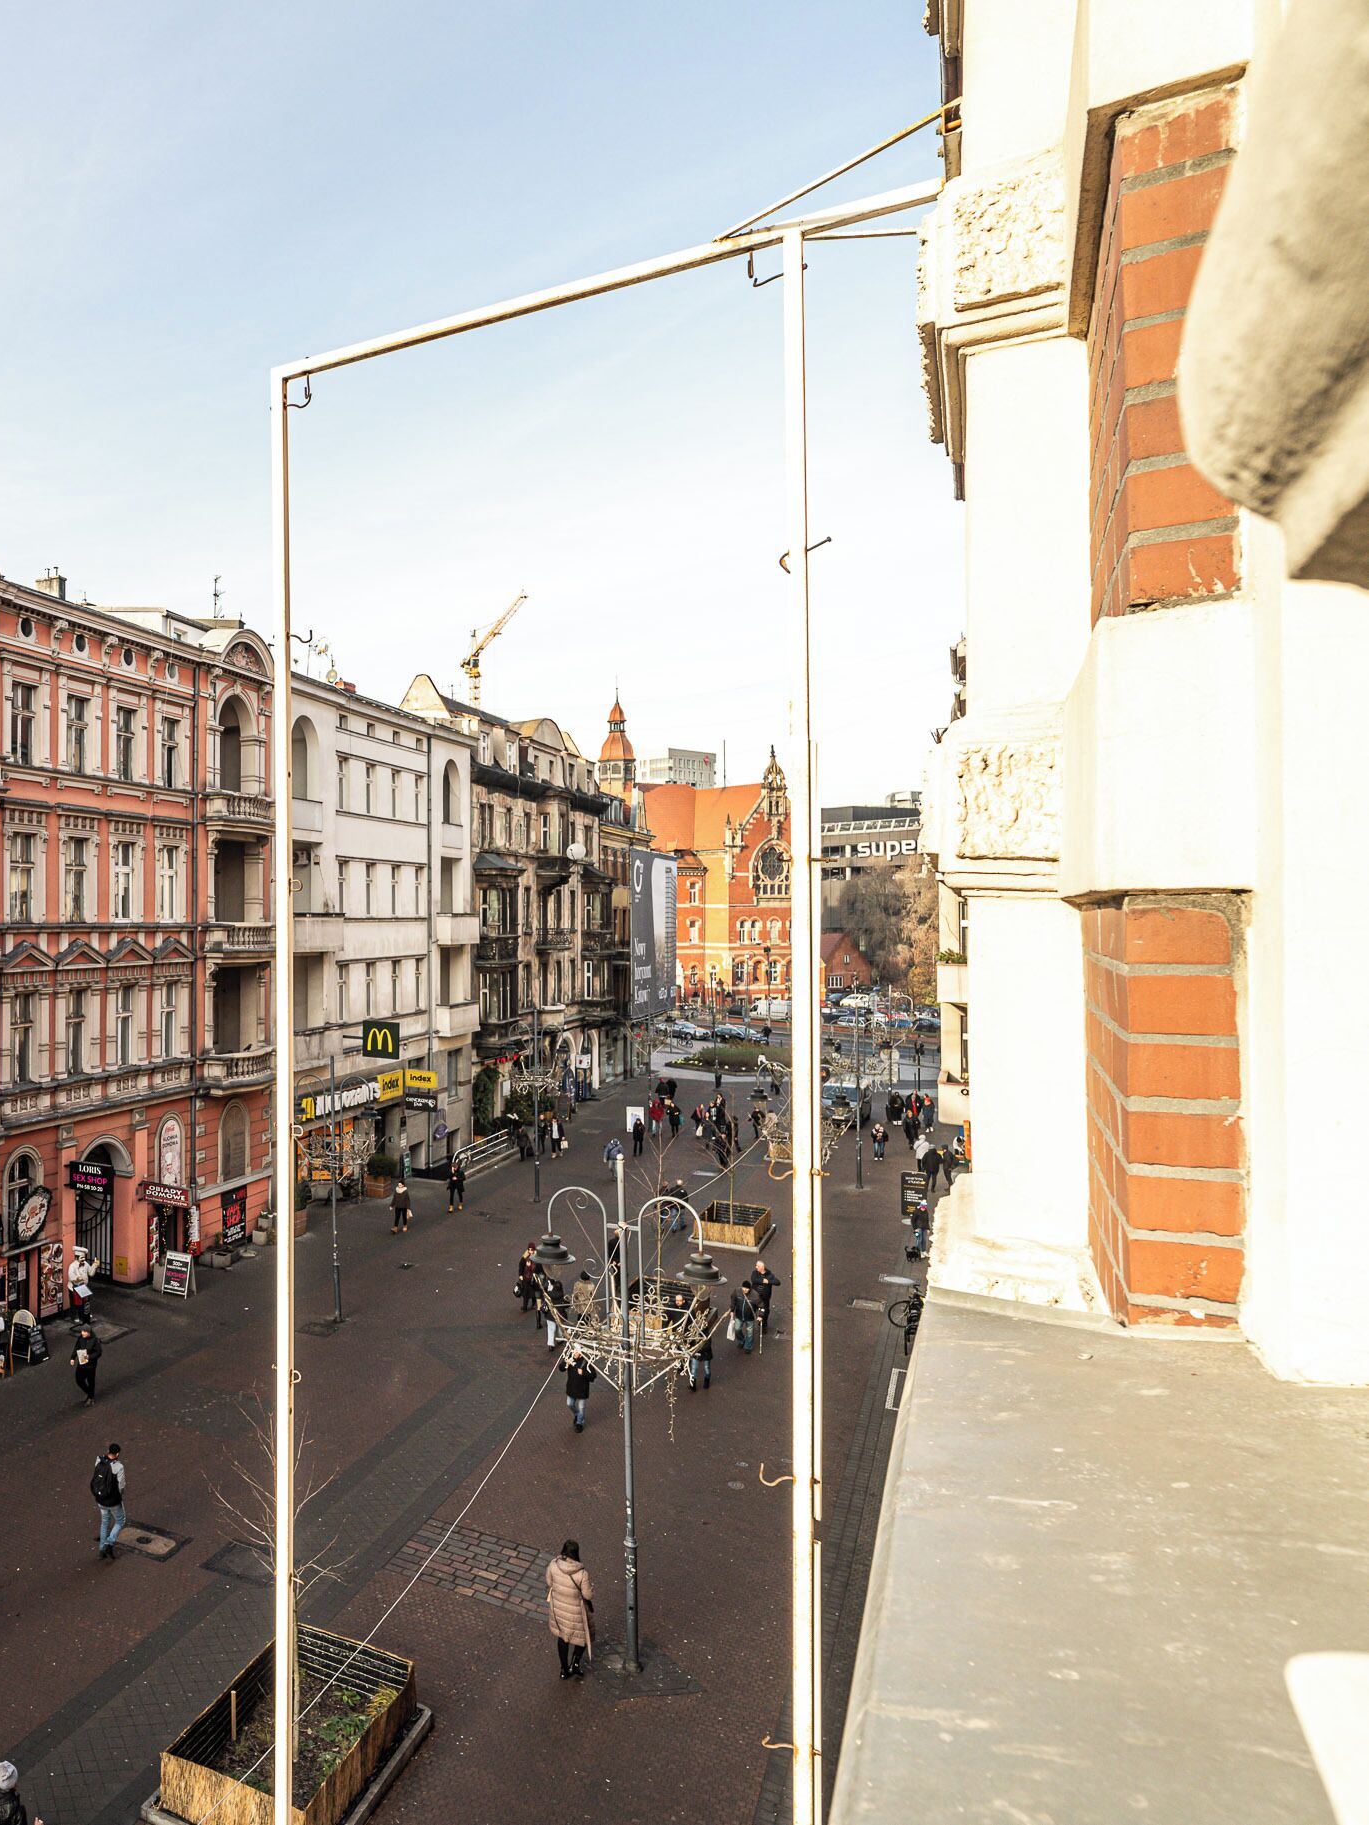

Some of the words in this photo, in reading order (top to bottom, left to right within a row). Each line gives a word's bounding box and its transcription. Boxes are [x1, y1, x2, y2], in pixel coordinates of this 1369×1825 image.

[382, 1077, 399, 1091] index
[410, 1074, 432, 1083] index
[79, 1165, 102, 1174] LORIS
[72, 1173, 86, 1182] SEX
[87, 1175, 108, 1185] SHOP
[146, 1189, 186, 1201] DOMOWE
[148, 1185, 183, 1195] OBIADY
